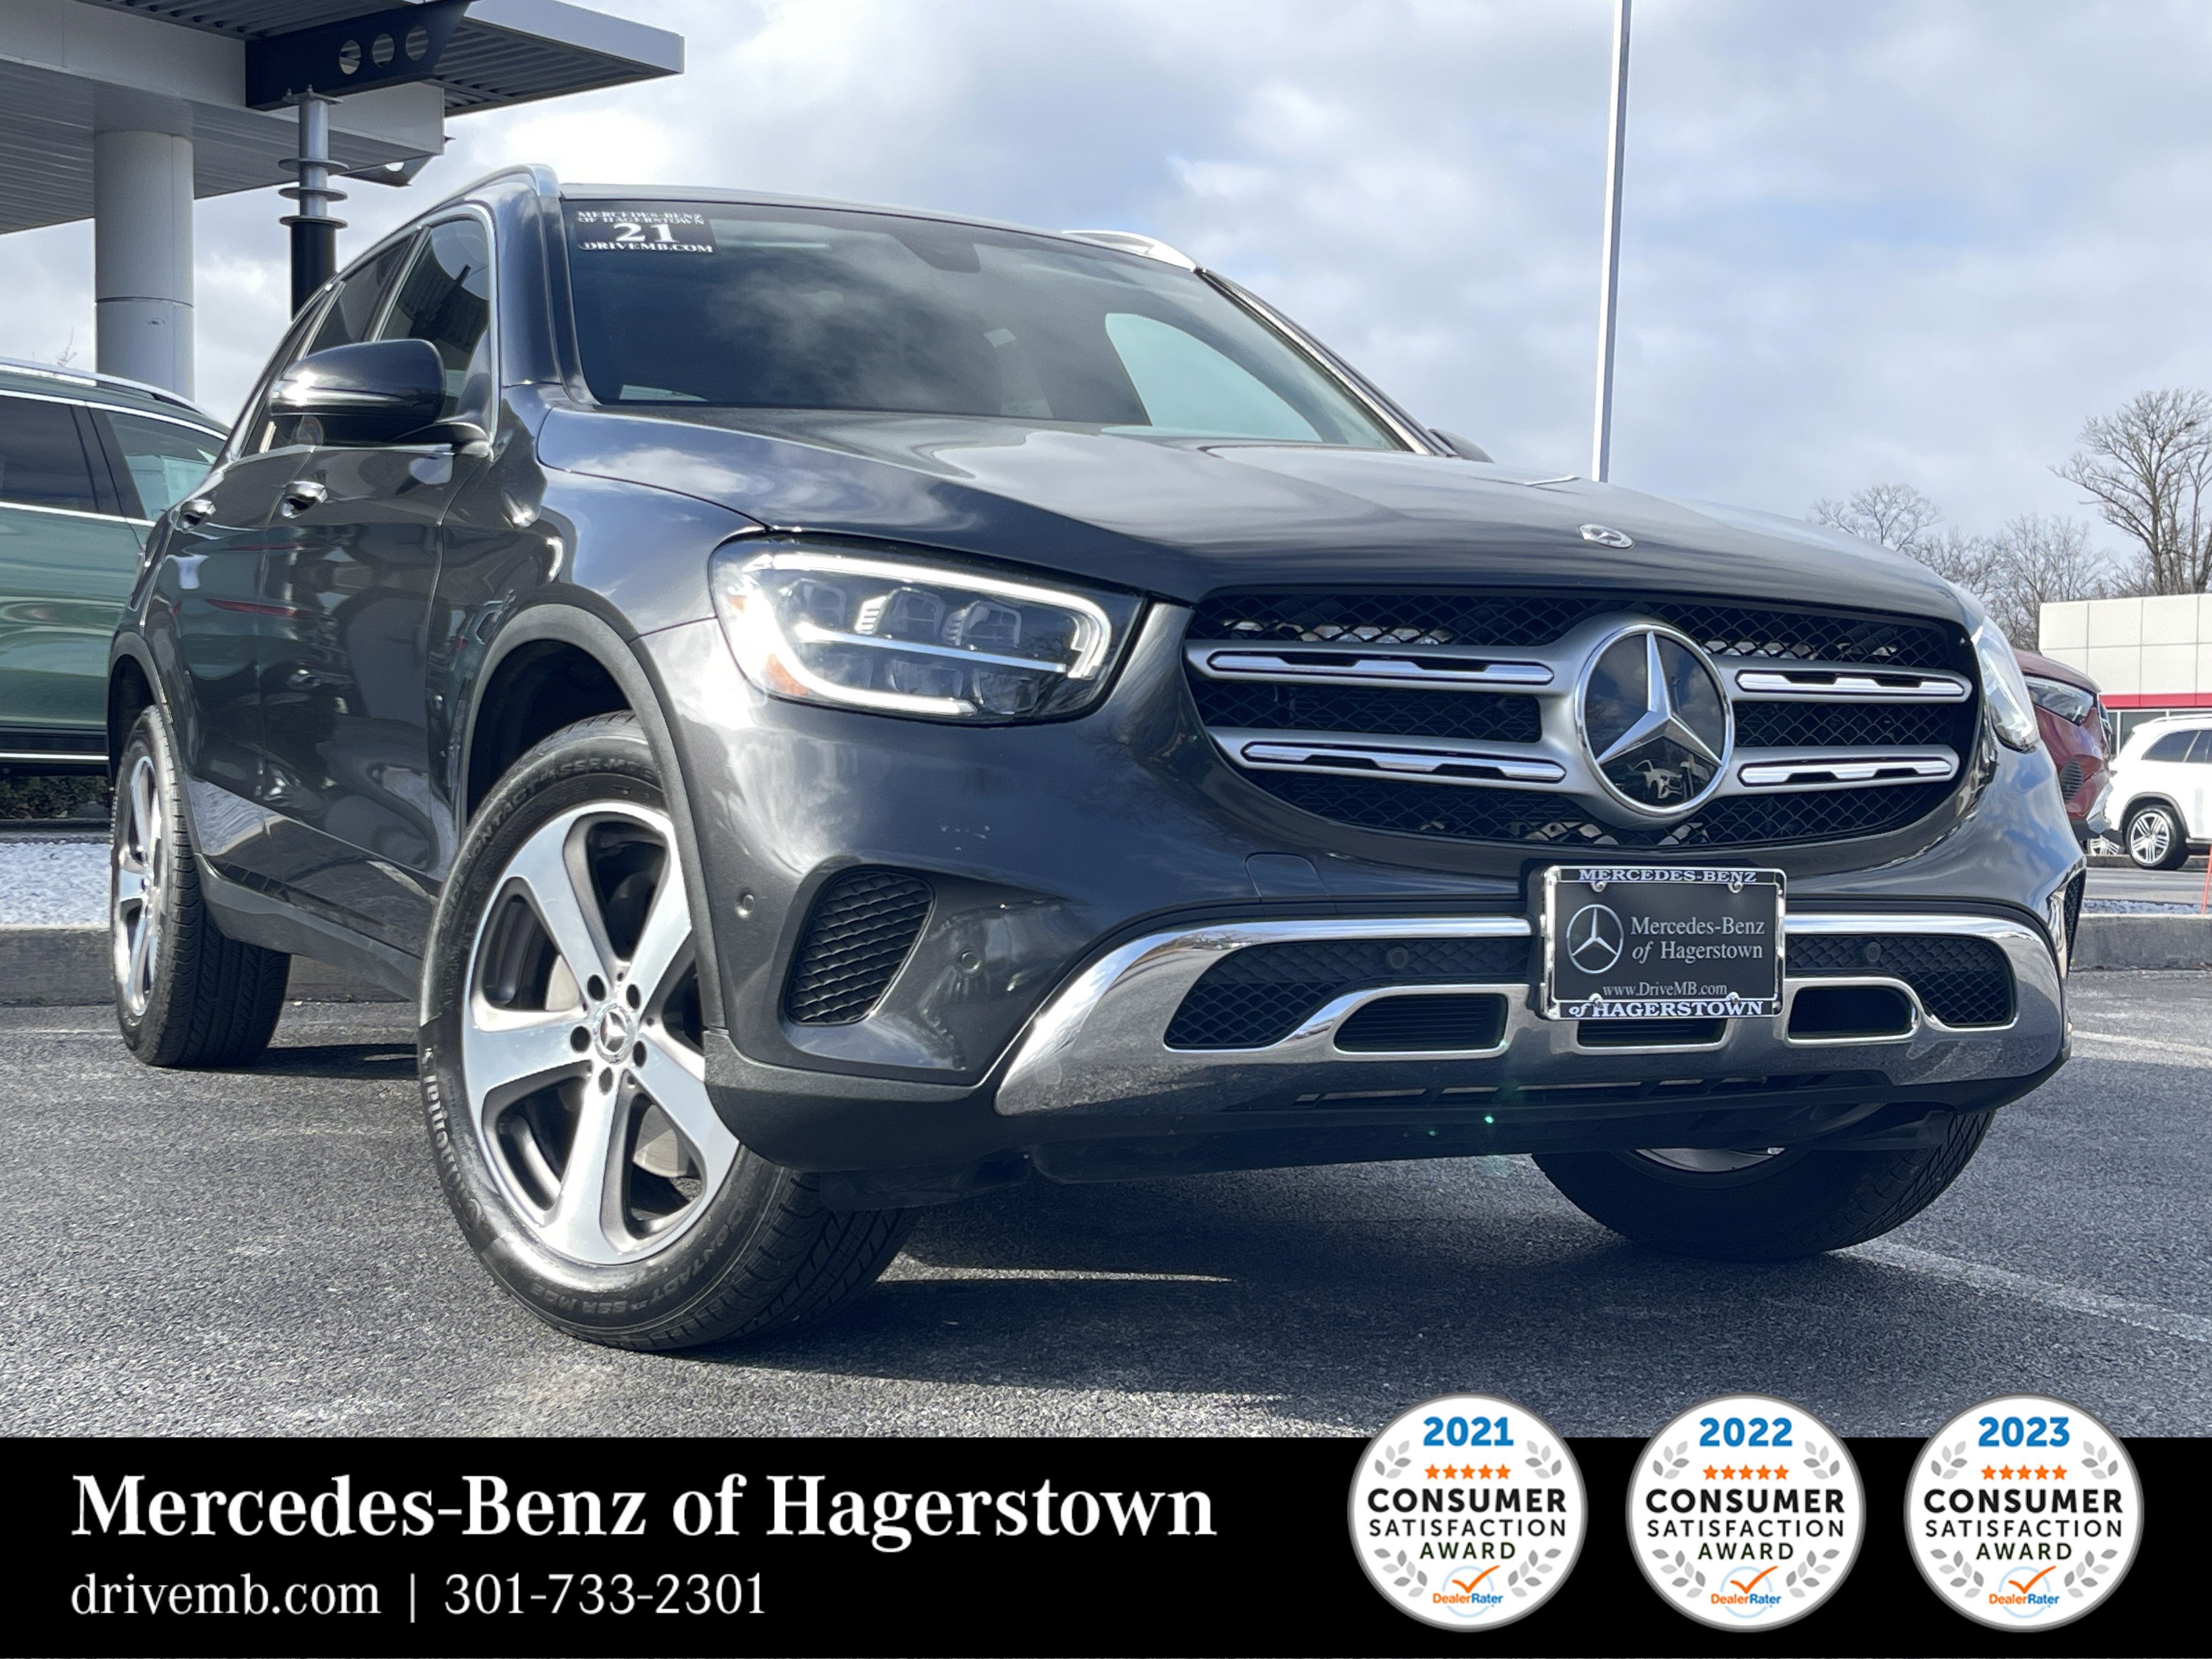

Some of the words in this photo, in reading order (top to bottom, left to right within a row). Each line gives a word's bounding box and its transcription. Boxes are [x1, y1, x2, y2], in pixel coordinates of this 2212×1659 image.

[613, 222, 680, 243] 21
[583, 241, 713, 253] DRIVEMB.COM
[1578, 868, 1757, 883] MERCEDES-BENZ
[1630, 917, 1765, 935] Mercedes-Benz
[1631, 941, 1654, 964] of
[1660, 941, 1764, 964] Hagerstown
[1602, 981, 1728, 997] www.DriveMB.com
[1568, 1002, 1590, 1017] of
[1591, 1001, 1764, 1017] HAGERSTOWN
